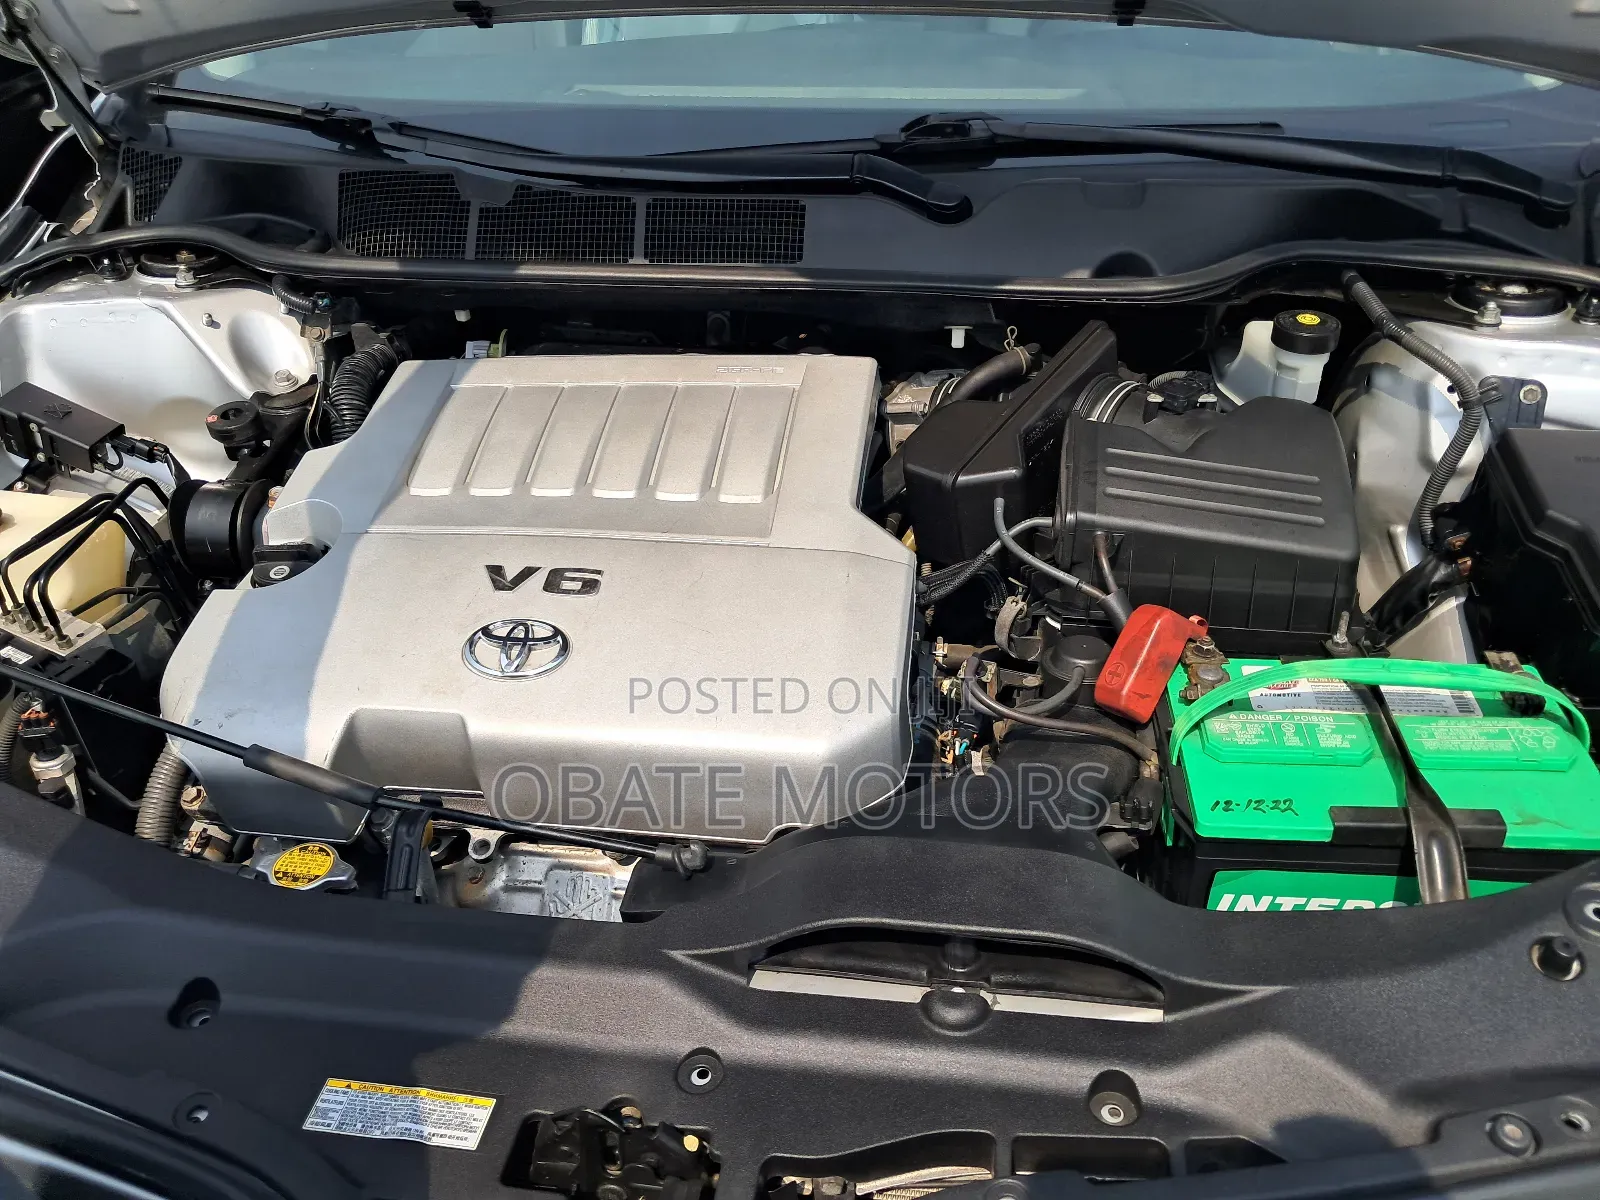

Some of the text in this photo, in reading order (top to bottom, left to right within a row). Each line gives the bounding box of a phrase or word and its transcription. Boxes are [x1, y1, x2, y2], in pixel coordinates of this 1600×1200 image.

[485, 565, 604, 596] V6
[1294, 715, 1334, 723] POISON
[358, 1084, 421, 1096] CAUTION ATTENTION
